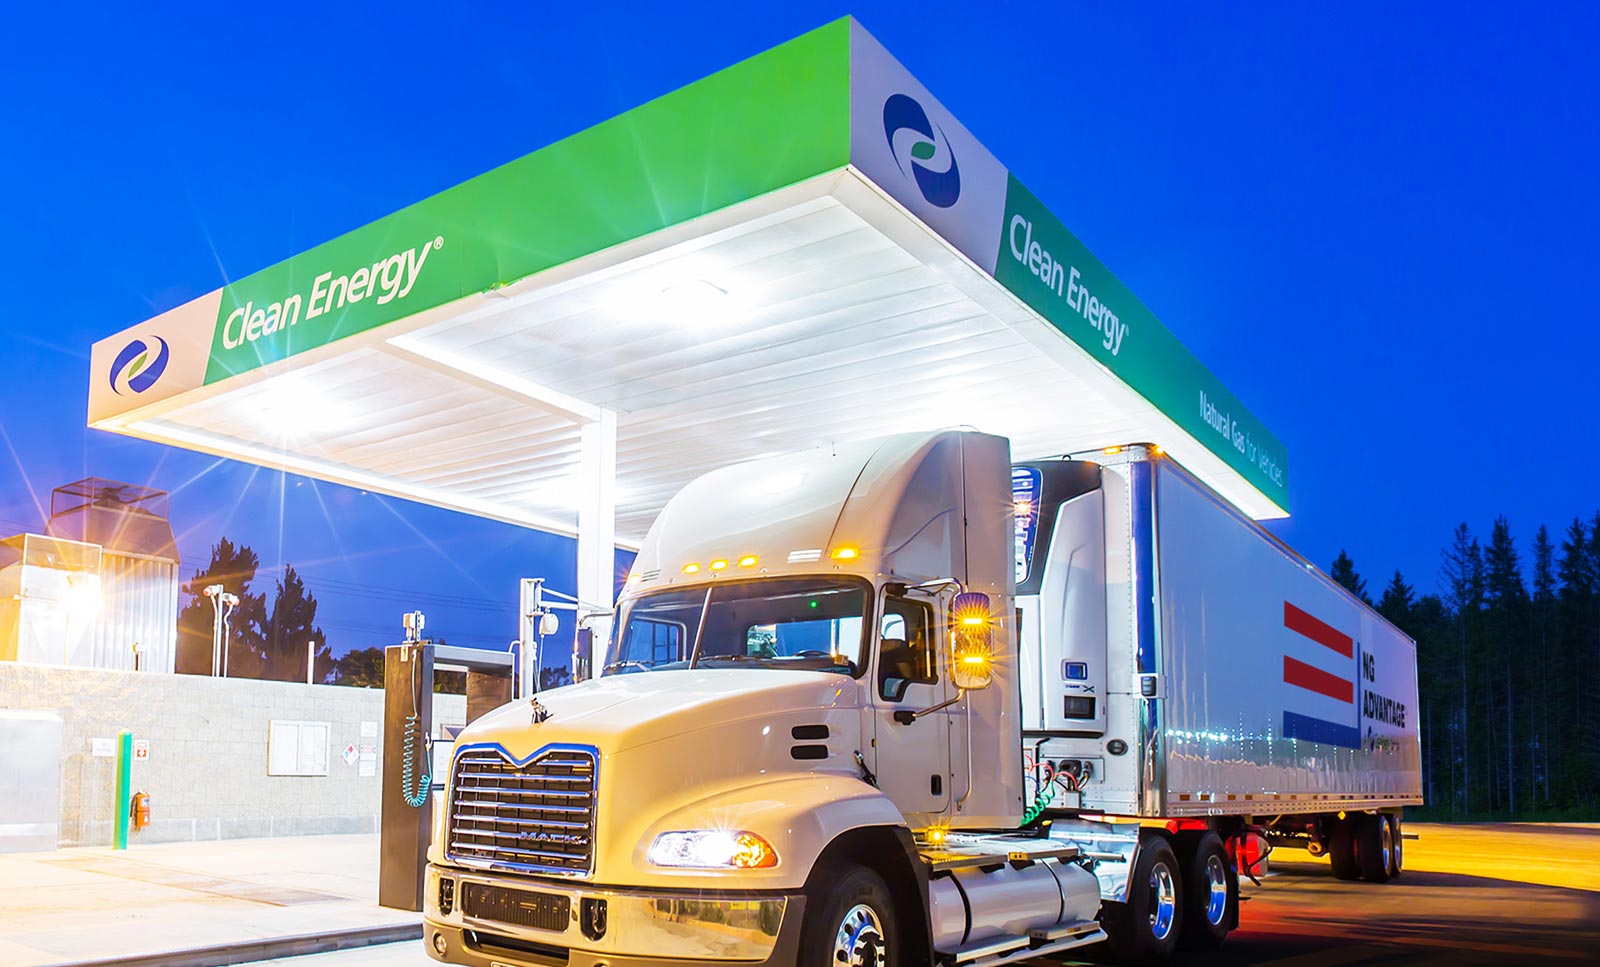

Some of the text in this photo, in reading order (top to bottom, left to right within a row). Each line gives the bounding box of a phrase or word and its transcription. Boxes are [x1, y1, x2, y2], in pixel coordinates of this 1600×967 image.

[1009, 213, 1126, 356] Clean Energy
[222, 293, 302, 350] Clean
[1200, 389, 1231, 440] Natural
[1231, 420, 1245, 454] Gas
[1362, 651, 1375, 683] NG
[1363, 688, 1406, 729] ADVANTAGE
[520, 831, 581, 845] MACK
